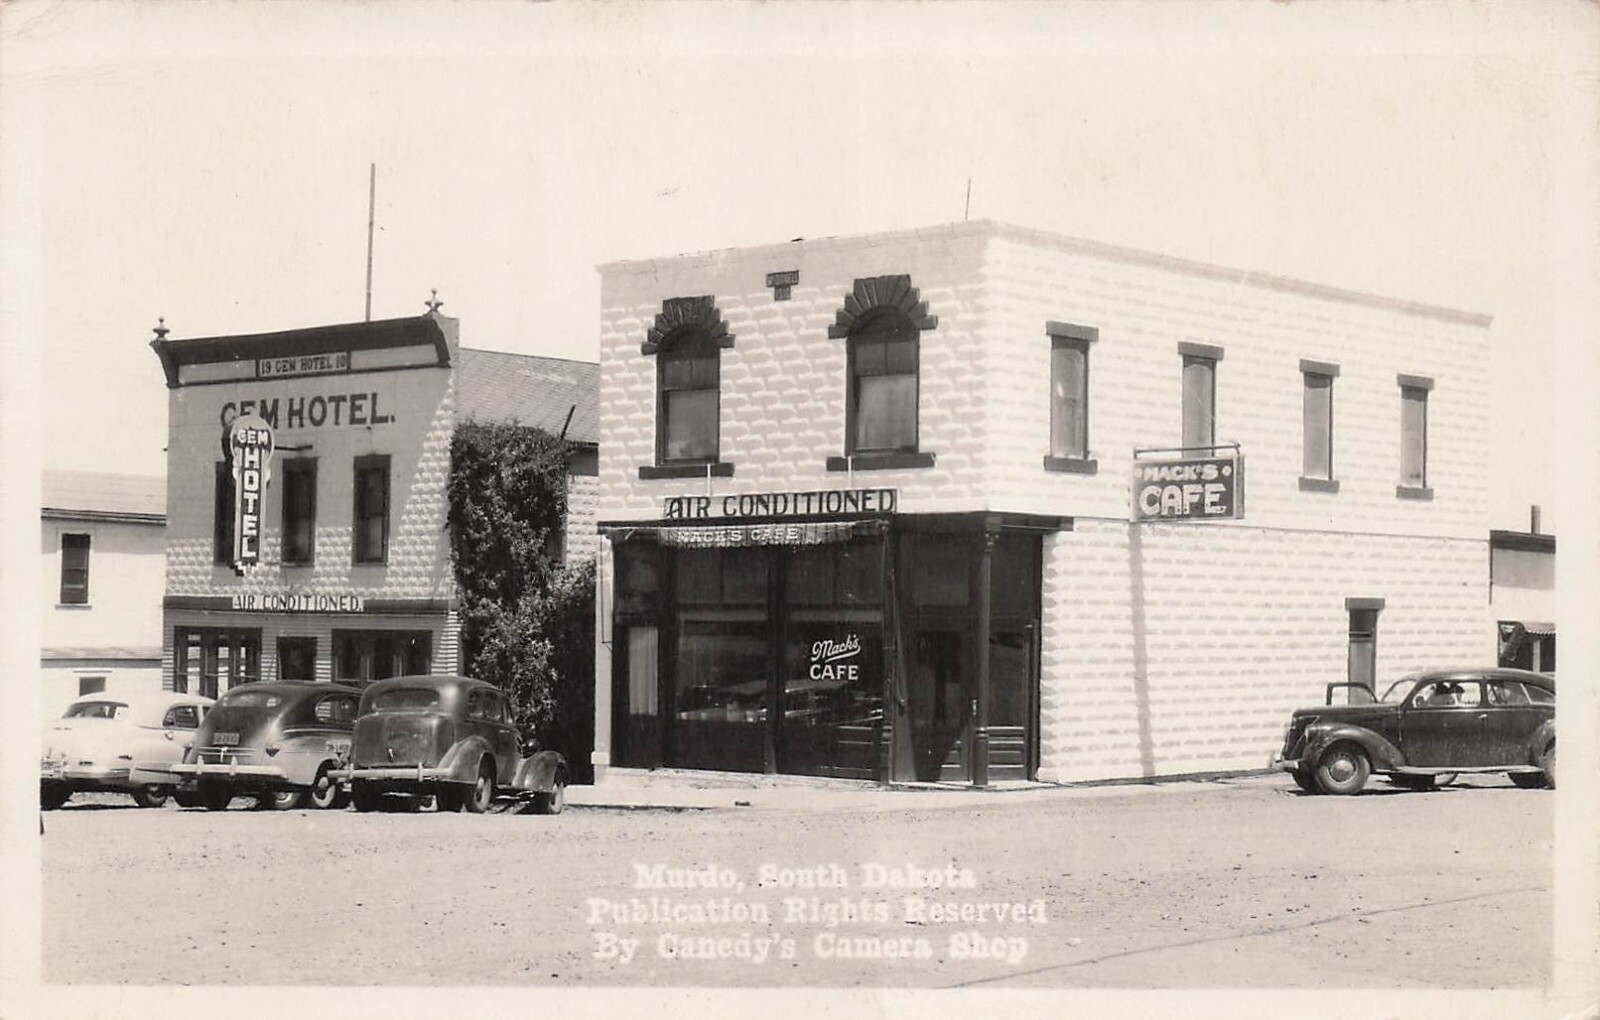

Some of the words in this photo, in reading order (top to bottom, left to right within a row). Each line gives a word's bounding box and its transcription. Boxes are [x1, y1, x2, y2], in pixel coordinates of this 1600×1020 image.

[300, 354, 333, 372] HOTEL
[237, 429, 269, 445] GEM
[1143, 464, 1219, 481] MACK'S
[241, 447, 260, 558] HOTEL
[665, 496, 711, 518] AIR
[723, 489, 895, 517] CONDITIONED
[1139, 483, 1227, 516] CAFE
[677, 527, 743, 543] MACK'S
[751, 527, 799, 541] CAFE
[233, 594, 255, 610] AIR
[811, 634, 860, 661] Mack's
[809, 664, 859, 680] CAFE
